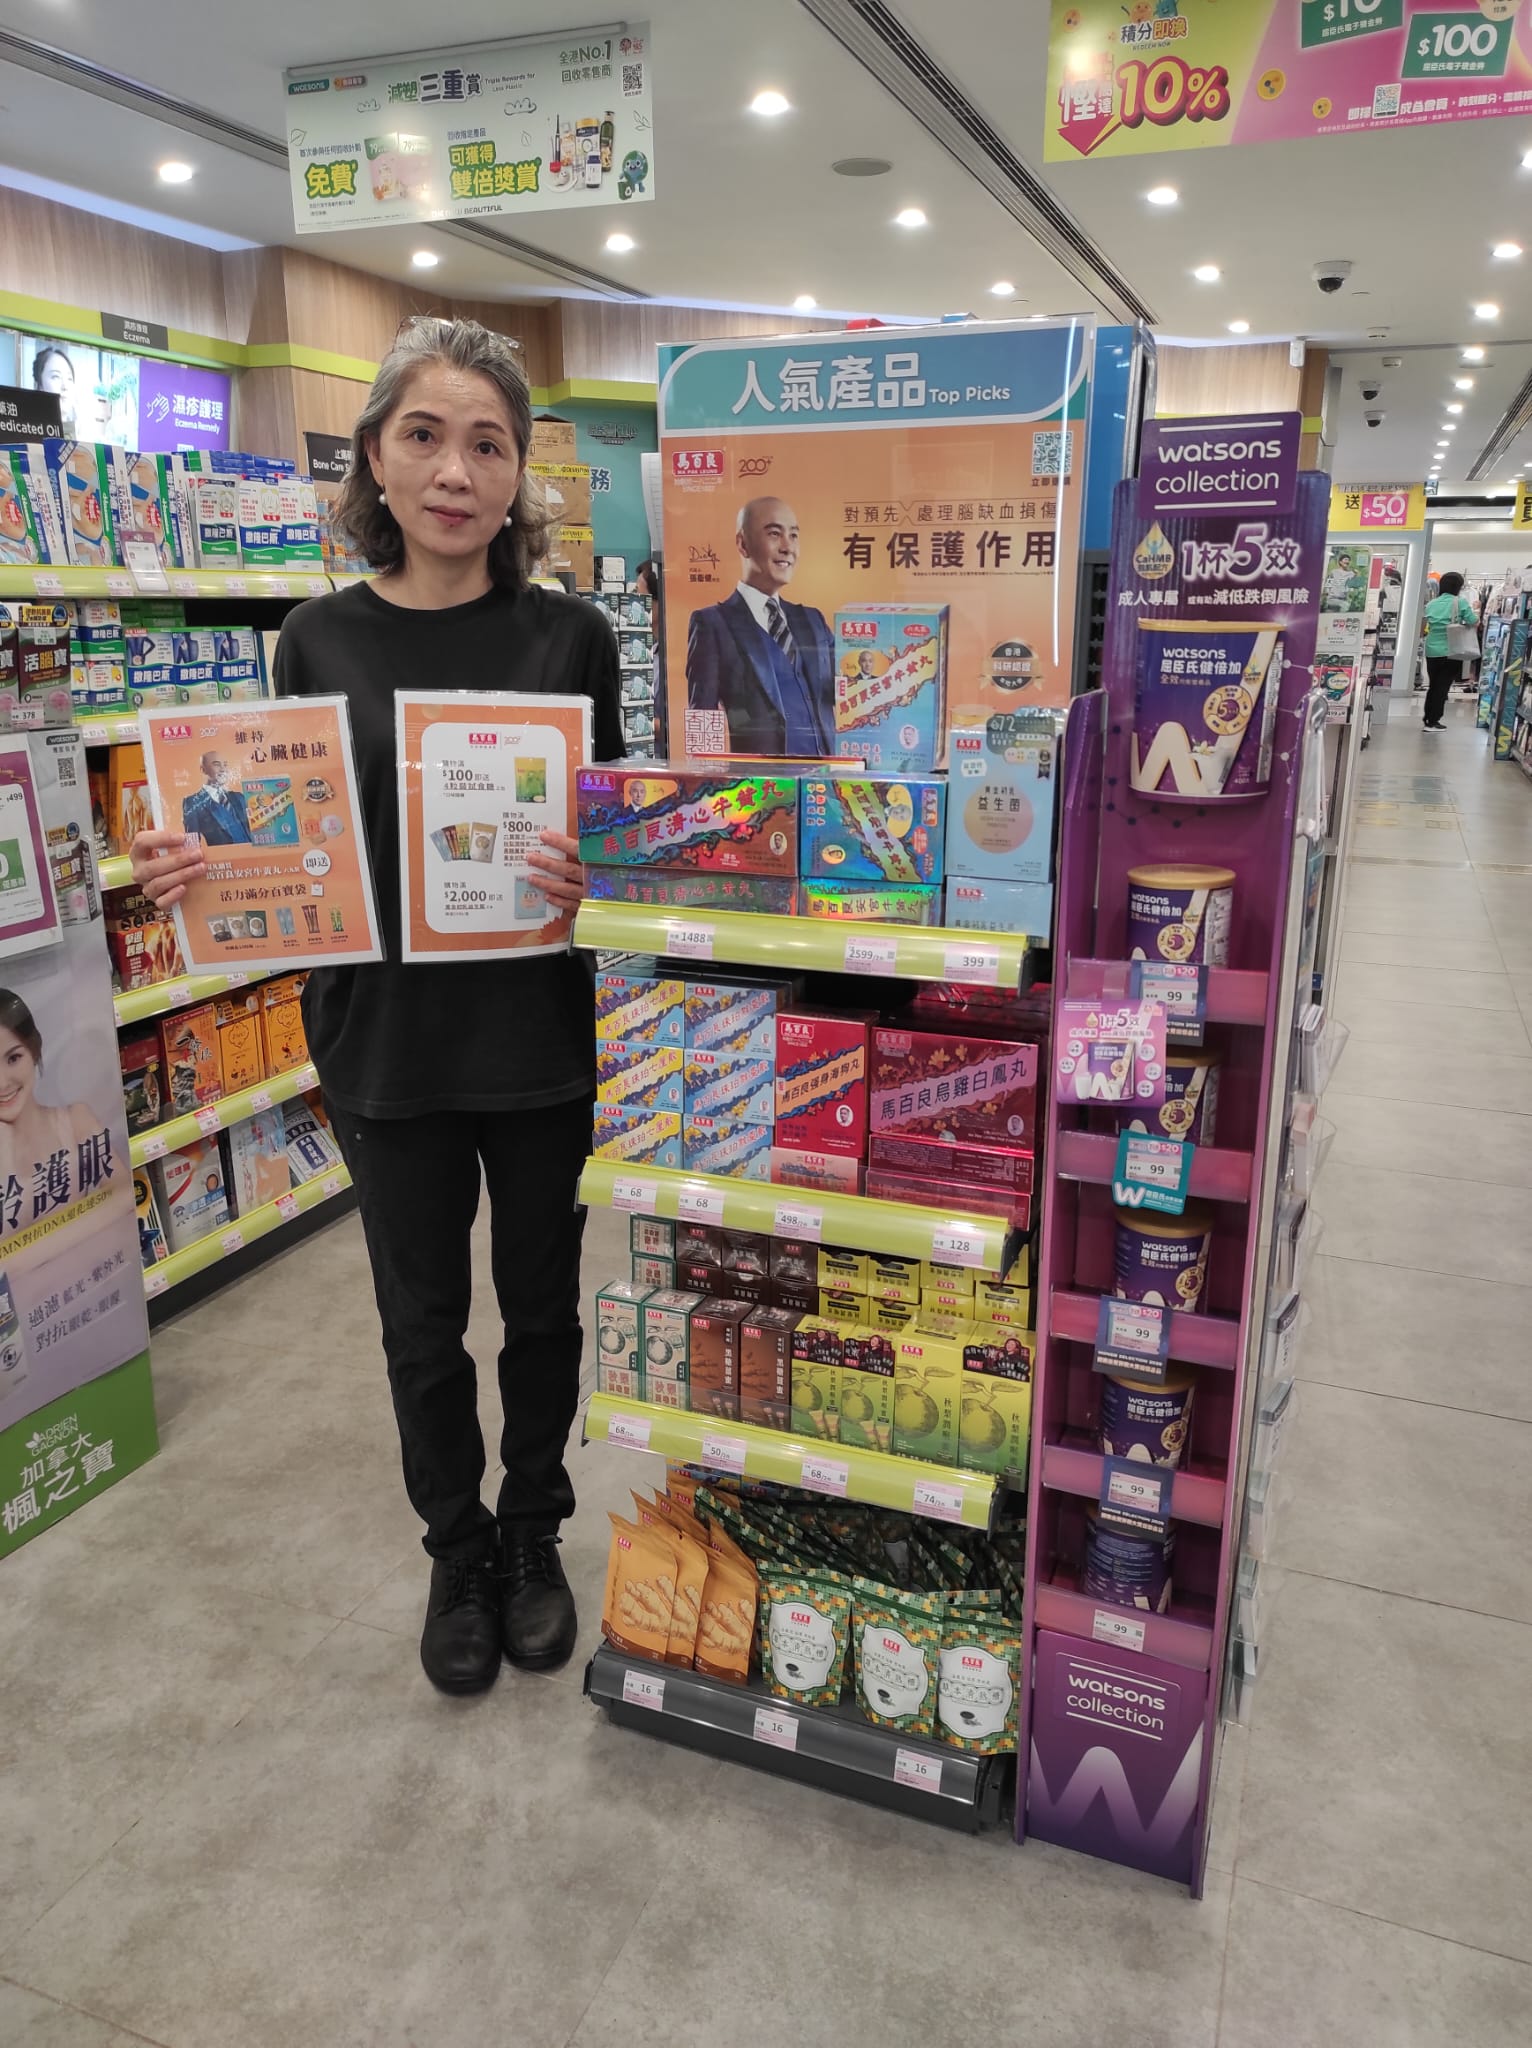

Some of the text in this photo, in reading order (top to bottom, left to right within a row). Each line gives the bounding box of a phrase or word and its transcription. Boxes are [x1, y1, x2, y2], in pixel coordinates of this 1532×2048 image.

[1417, 23, 1498, 57] $100
[560, 40, 611, 66] 全港No.1
[562, 64, 611, 83] 回收零售商
[1118, 58, 1222, 118] 10%
[451, 144, 494, 166] 可獲得
[307, 161, 354, 197] 免費
[450, 163, 538, 199] 雙倍獎賞
[123, 331, 151, 344] Eczema
[731, 352, 1011, 415] 人氣產品 Top Picks
[172, 393, 224, 421] 濕疹護理
[46, 423, 60, 437] Oil
[1158, 440, 1282, 464] watsons
[312, 458, 344, 472] Bone Care
[677, 453, 718, 470] 馬百良
[1156, 468, 1280, 494] collection
[1345, 494, 1406, 519] 送 $50
[844, 506, 899, 523] 對預先
[843, 530, 1057, 570] 有保護作用
[1182, 522, 1299, 581] 1杯5效
[1118, 590, 1179, 606] 成人專屬
[1005, 647, 1021, 657] 香港
[1163, 648, 1227, 659] watsons
[1160, 661, 1242, 675] 屈臣氏健倍加
[22, 711, 36, 720] 378
[686, 712, 725, 731] 香港
[50, 735, 78, 743] watsons
[235, 731, 264, 744] 維持
[251, 741, 328, 763] 心臟健康
[442, 769, 474, 782] $100
[978, 797, 1021, 812] 益生菌
[602, 779, 785, 858] 馬百良清心牛黃丸
[503, 821, 533, 833] $800
[305, 856, 329, 868] 即送
[220, 884, 307, 902] 活力滿分百寶袋
[444, 890, 487, 903] $2,000
[1131, 894, 1169, 905] watsons
[681, 932, 707, 943] 1488
[963, 956, 985, 967] 399
[1167, 991, 1183, 1002] 99
[881, 1058, 1027, 1121] 馬百良烏雞白鳳丸
[1150, 1164, 1165, 1175] 99
[630, 1187, 642, 1198] 68
[696, 1198, 708, 1209] 68
[781, 1214, 798, 1225] 498
[950, 1239, 970, 1251] 128
[1141, 1241, 1188, 1253] watsons
[1136, 1328, 1150, 1338] 99
[1128, 1395, 1173, 1407] watsons
[39, 1413, 79, 1442] ADRIEN
[615, 1425, 625, 1434] 68
[31, 1423, 79, 1457] GAGNON
[711, 1447, 721, 1457] 50
[20, 1432, 94, 1490] 加拿大
[811, 1470, 822, 1479] 68
[2, 1438, 116, 1535] 楓之寶
[1130, 1485, 1145, 1495] 99
[924, 1494, 936, 1504] 74
[1113, 1623, 1128, 1635] 99
[641, 1684, 652, 1694] 16
[1068, 1673, 1167, 1711] watsons
[1066, 1694, 1165, 1731] collection
[772, 1723, 783, 1733] 16
[915, 1763, 927, 1774] 16
